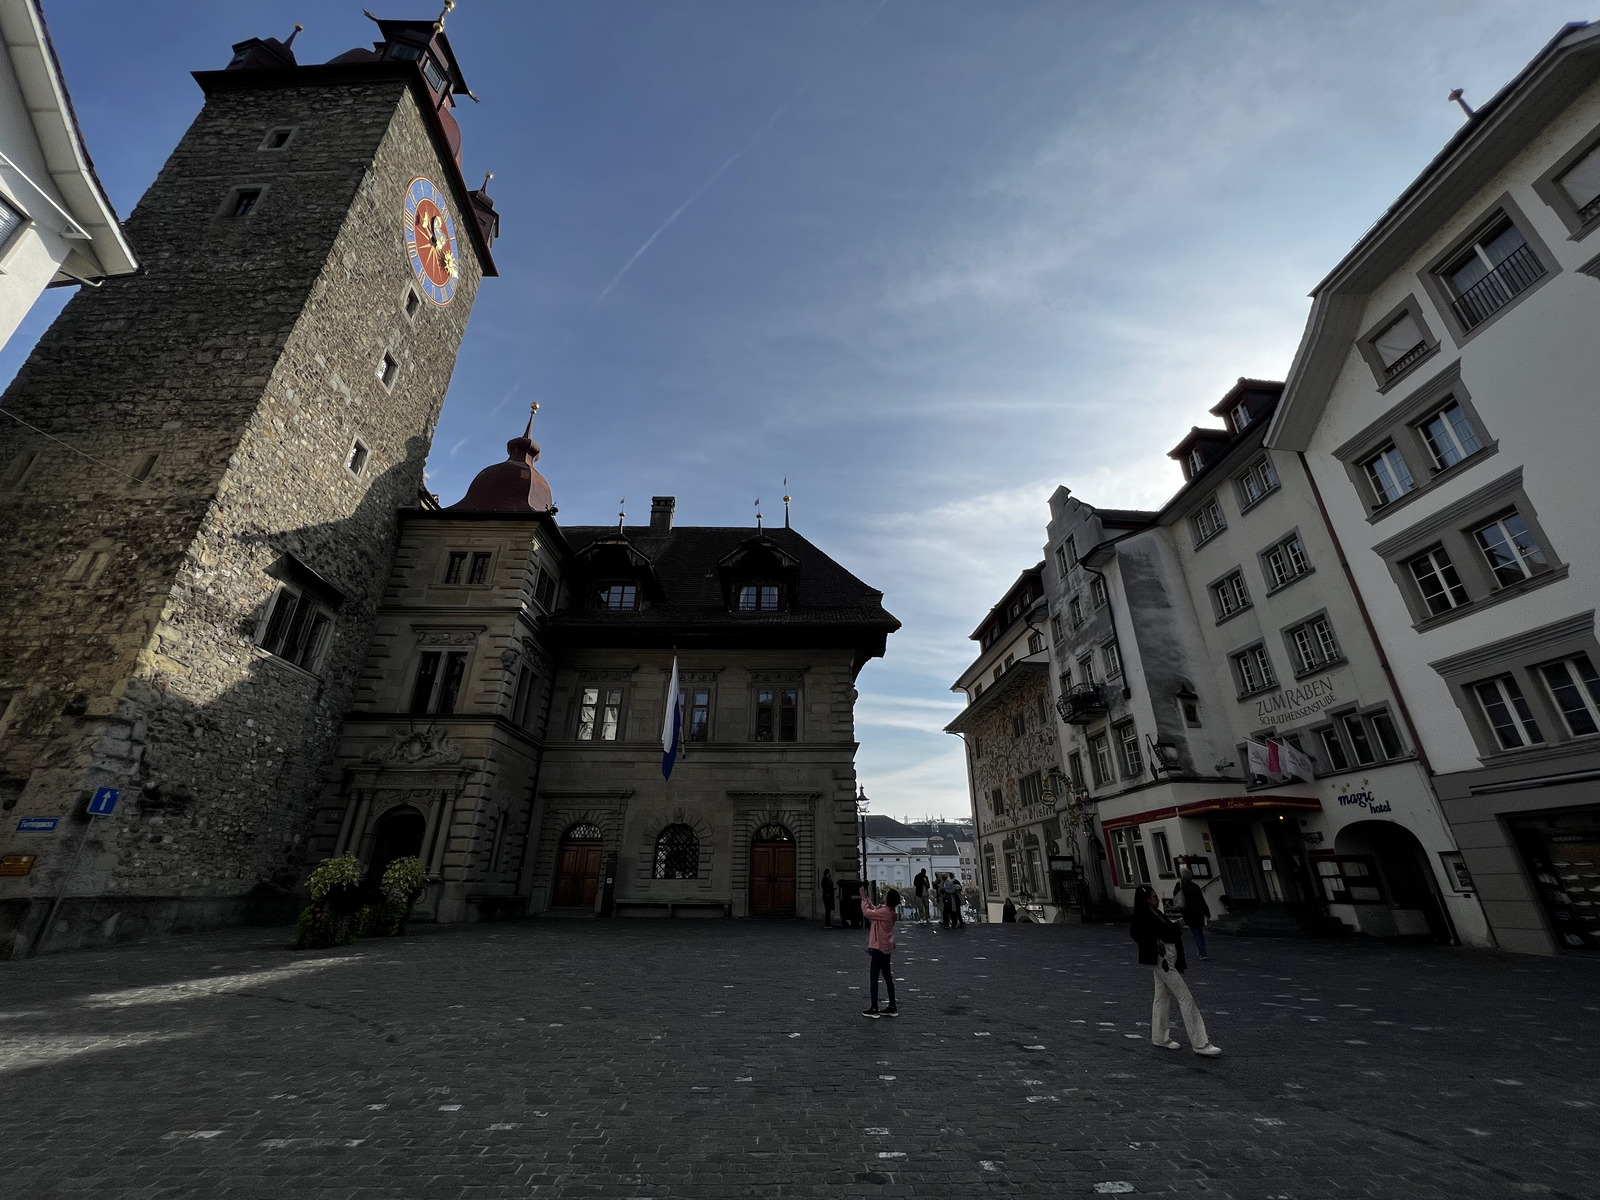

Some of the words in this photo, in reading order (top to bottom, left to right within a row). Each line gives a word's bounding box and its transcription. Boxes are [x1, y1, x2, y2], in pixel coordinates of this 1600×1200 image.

[1256, 694, 1286, 716] ZUM
[1285, 676, 1333, 709] RABEN
[1260, 692, 1336, 725] SCHULTHEISSENSTUBE
[1338, 787, 1374, 807] magic
[1369, 800, 1391, 813] hotel
